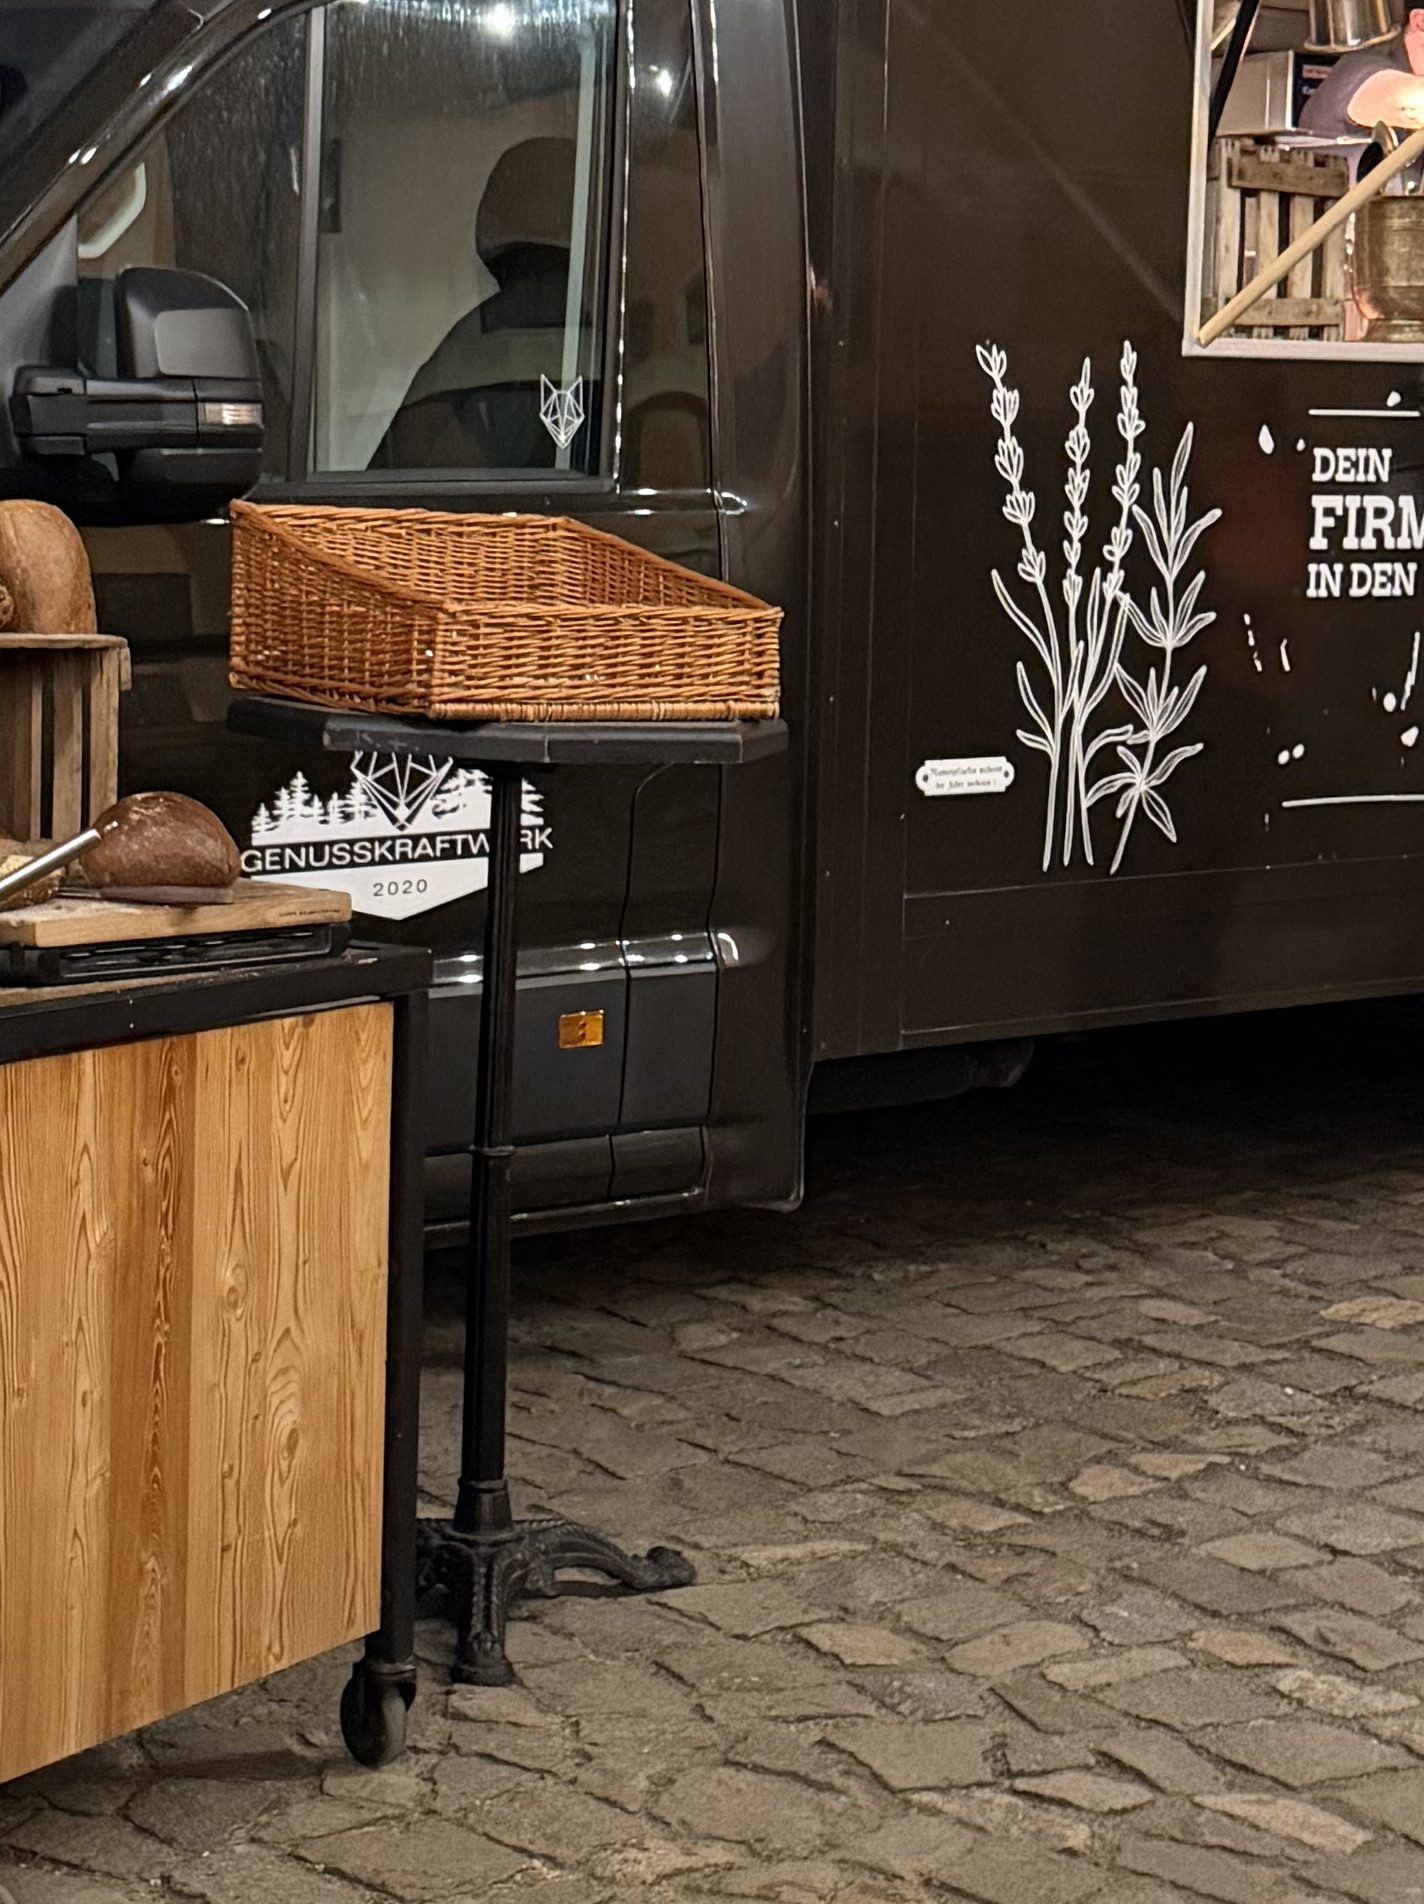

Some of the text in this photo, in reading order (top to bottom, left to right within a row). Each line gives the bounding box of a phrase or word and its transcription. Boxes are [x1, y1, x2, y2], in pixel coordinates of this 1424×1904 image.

[1312, 448, 1392, 483] DEIN
[1306, 562, 1417, 598] IN DEN
[240, 827, 554, 873] GENUSSKRAFTWRK
[373, 879, 428, 897] 2020
